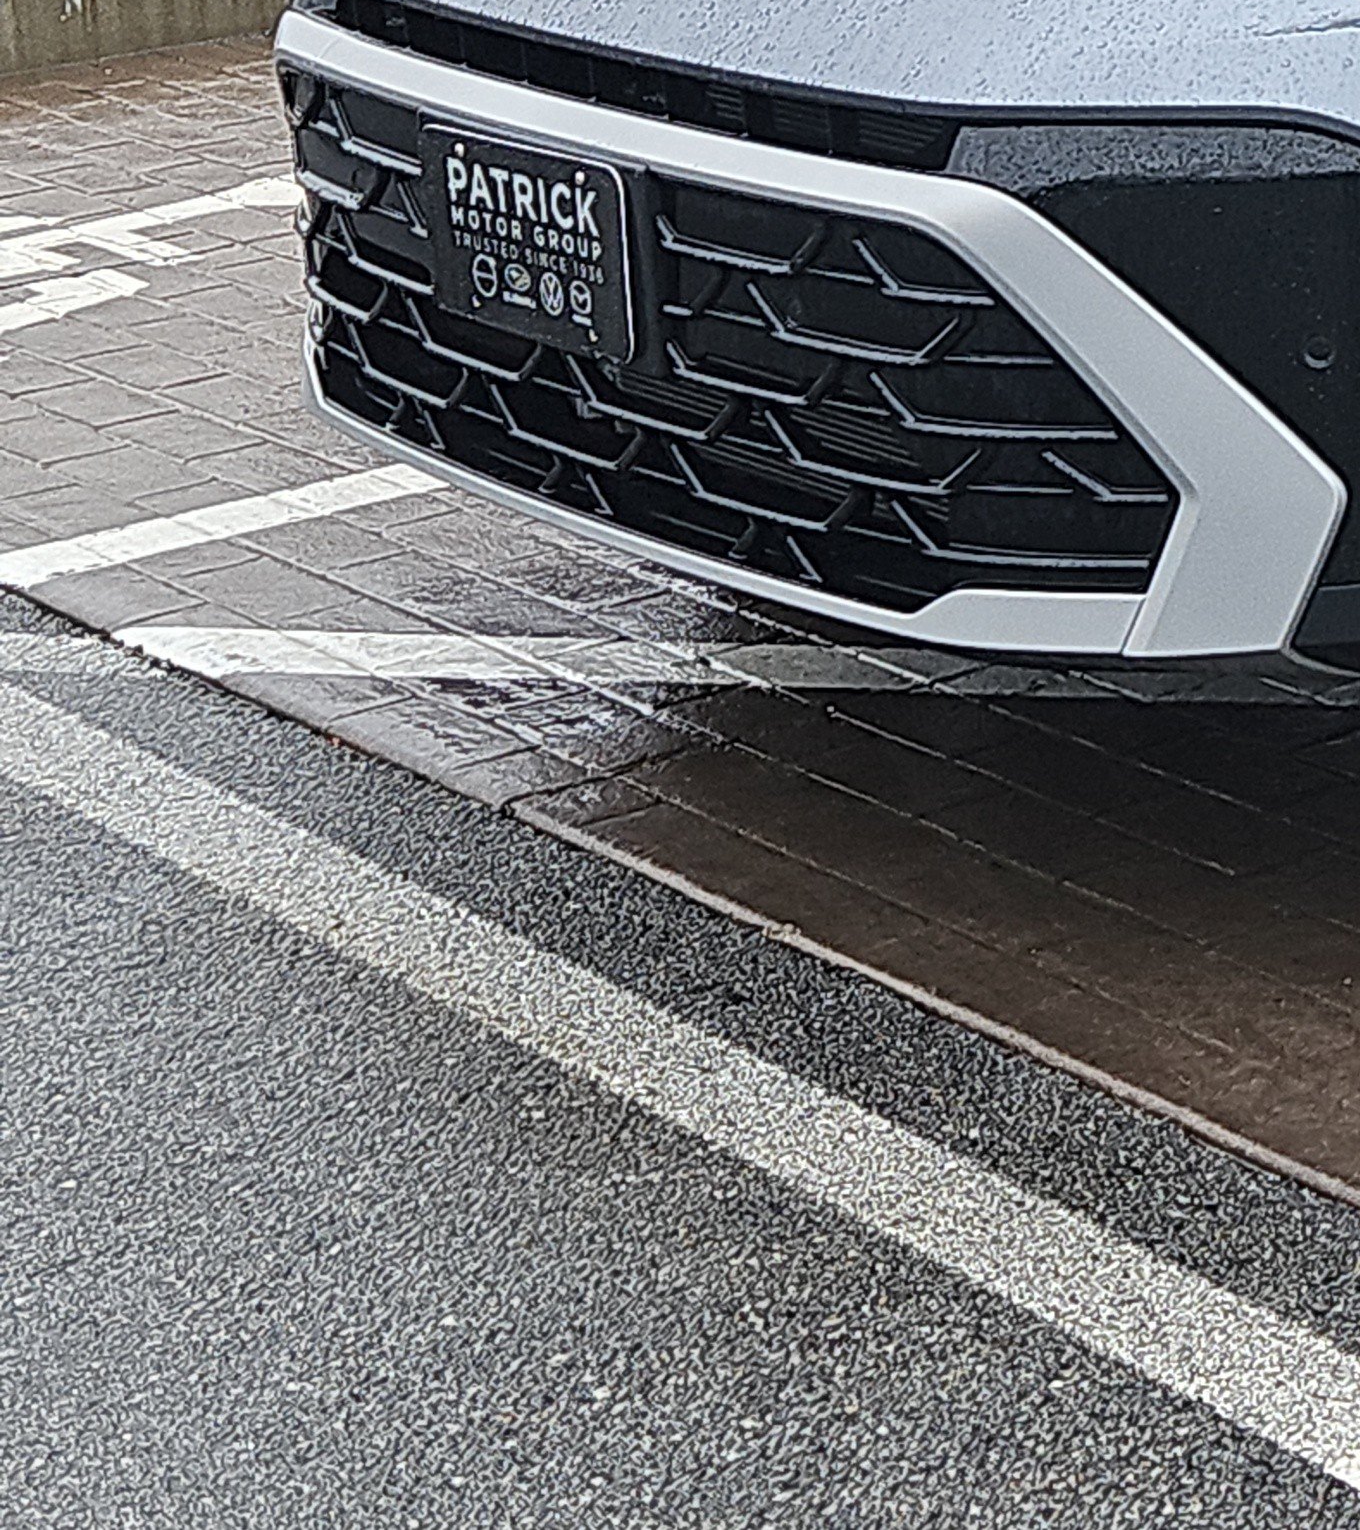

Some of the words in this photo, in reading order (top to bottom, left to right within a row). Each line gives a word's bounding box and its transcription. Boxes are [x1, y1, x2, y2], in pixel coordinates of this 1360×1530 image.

[446, 156, 600, 237] PATRICK
[451, 205, 523, 240] MOTOR
[533, 225, 602, 261] GROUP
[454, 230, 518, 259] TRUSTED
[525, 248, 567, 272] SINCE
